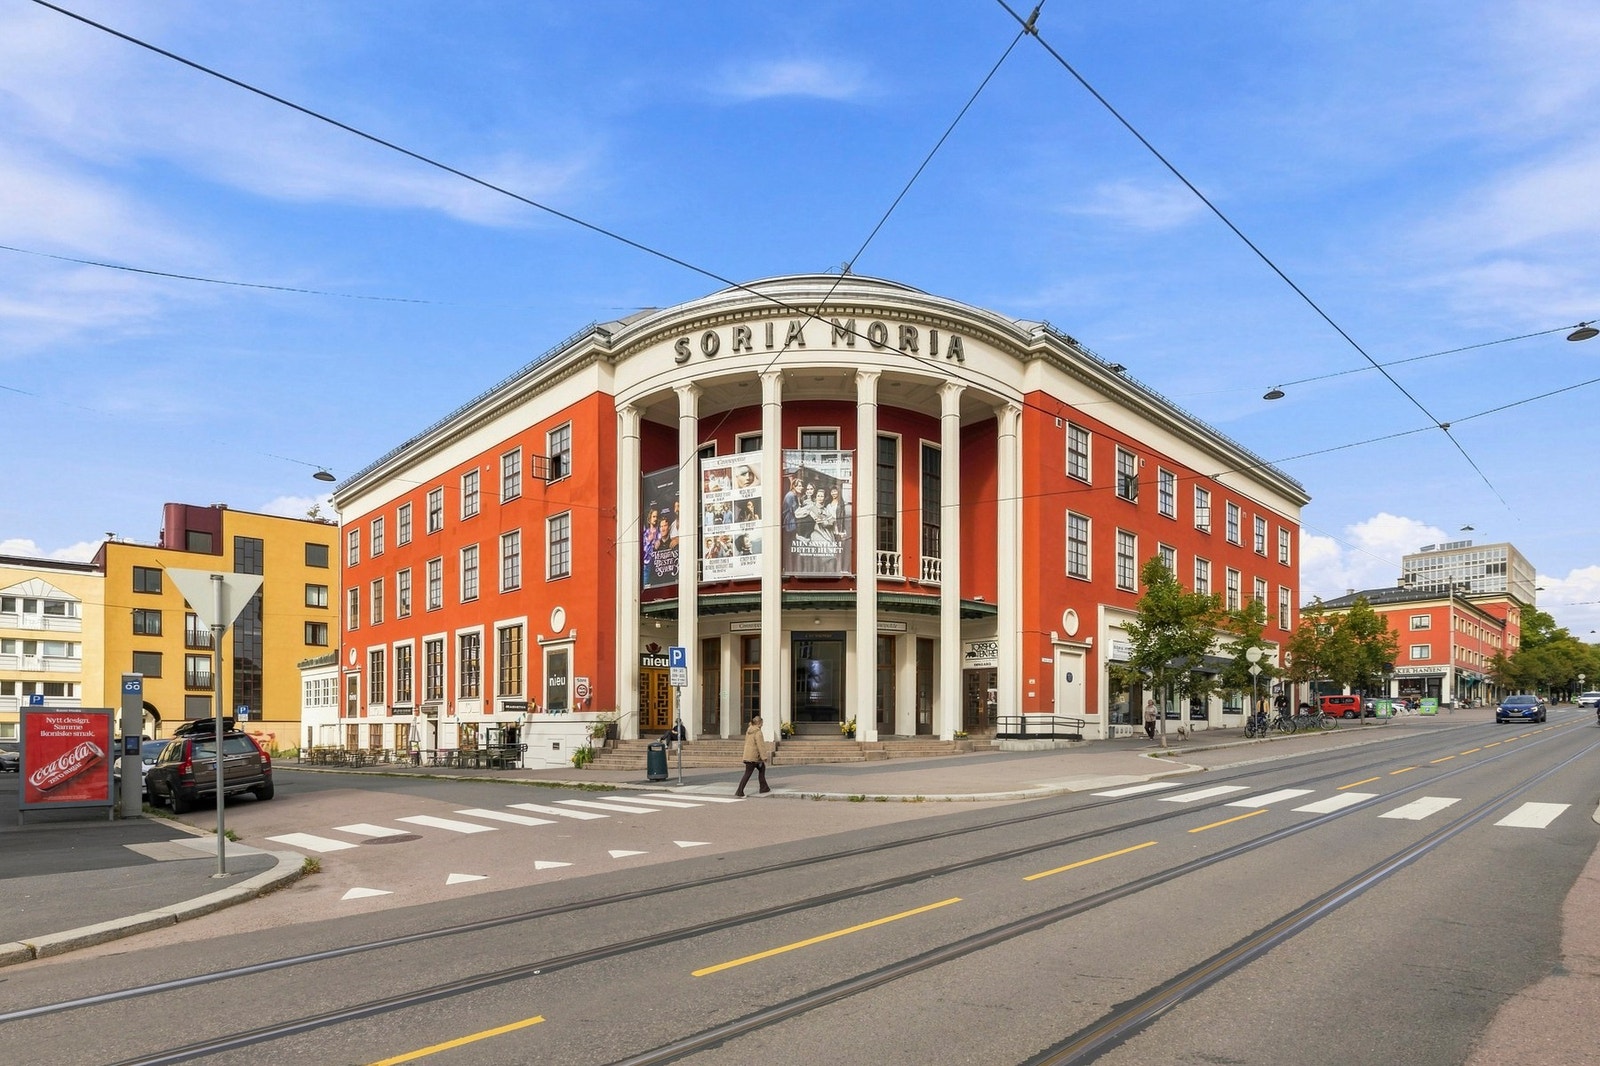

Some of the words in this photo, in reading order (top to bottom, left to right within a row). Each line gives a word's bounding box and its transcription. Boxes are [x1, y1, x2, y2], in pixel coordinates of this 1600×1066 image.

[674, 320, 806, 364] SORIA
[831, 318, 966, 362] MORIA
[642, 655, 669, 667] nieu
[673, 649, 682, 665] P
[549, 674, 566, 687] nieu
[32, 695, 41, 703] P
[240, 706, 247, 714] P
